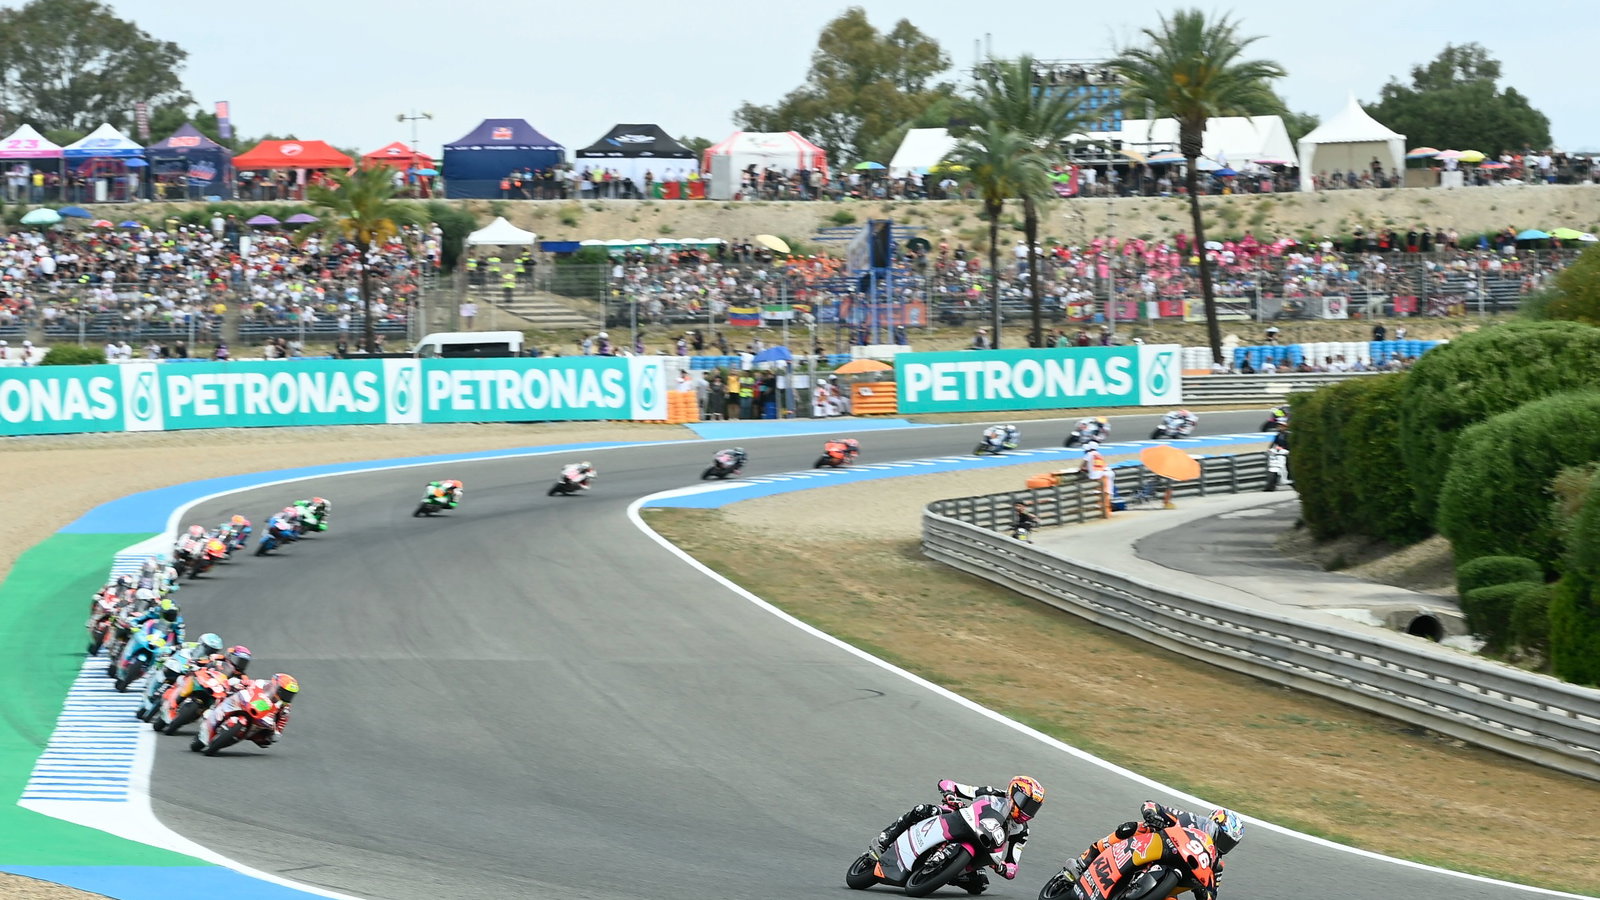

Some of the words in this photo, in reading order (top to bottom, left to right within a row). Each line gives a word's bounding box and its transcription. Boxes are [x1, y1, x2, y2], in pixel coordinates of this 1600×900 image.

[166, 371, 380, 417] PETRONAS
[427, 368, 626, 411] PETRONAS
[904, 356, 1132, 402] PETRONAS
[980, 818, 1005, 847] 48
[1185, 839, 1210, 869] 96
[1093, 857, 1115, 891] KTM
